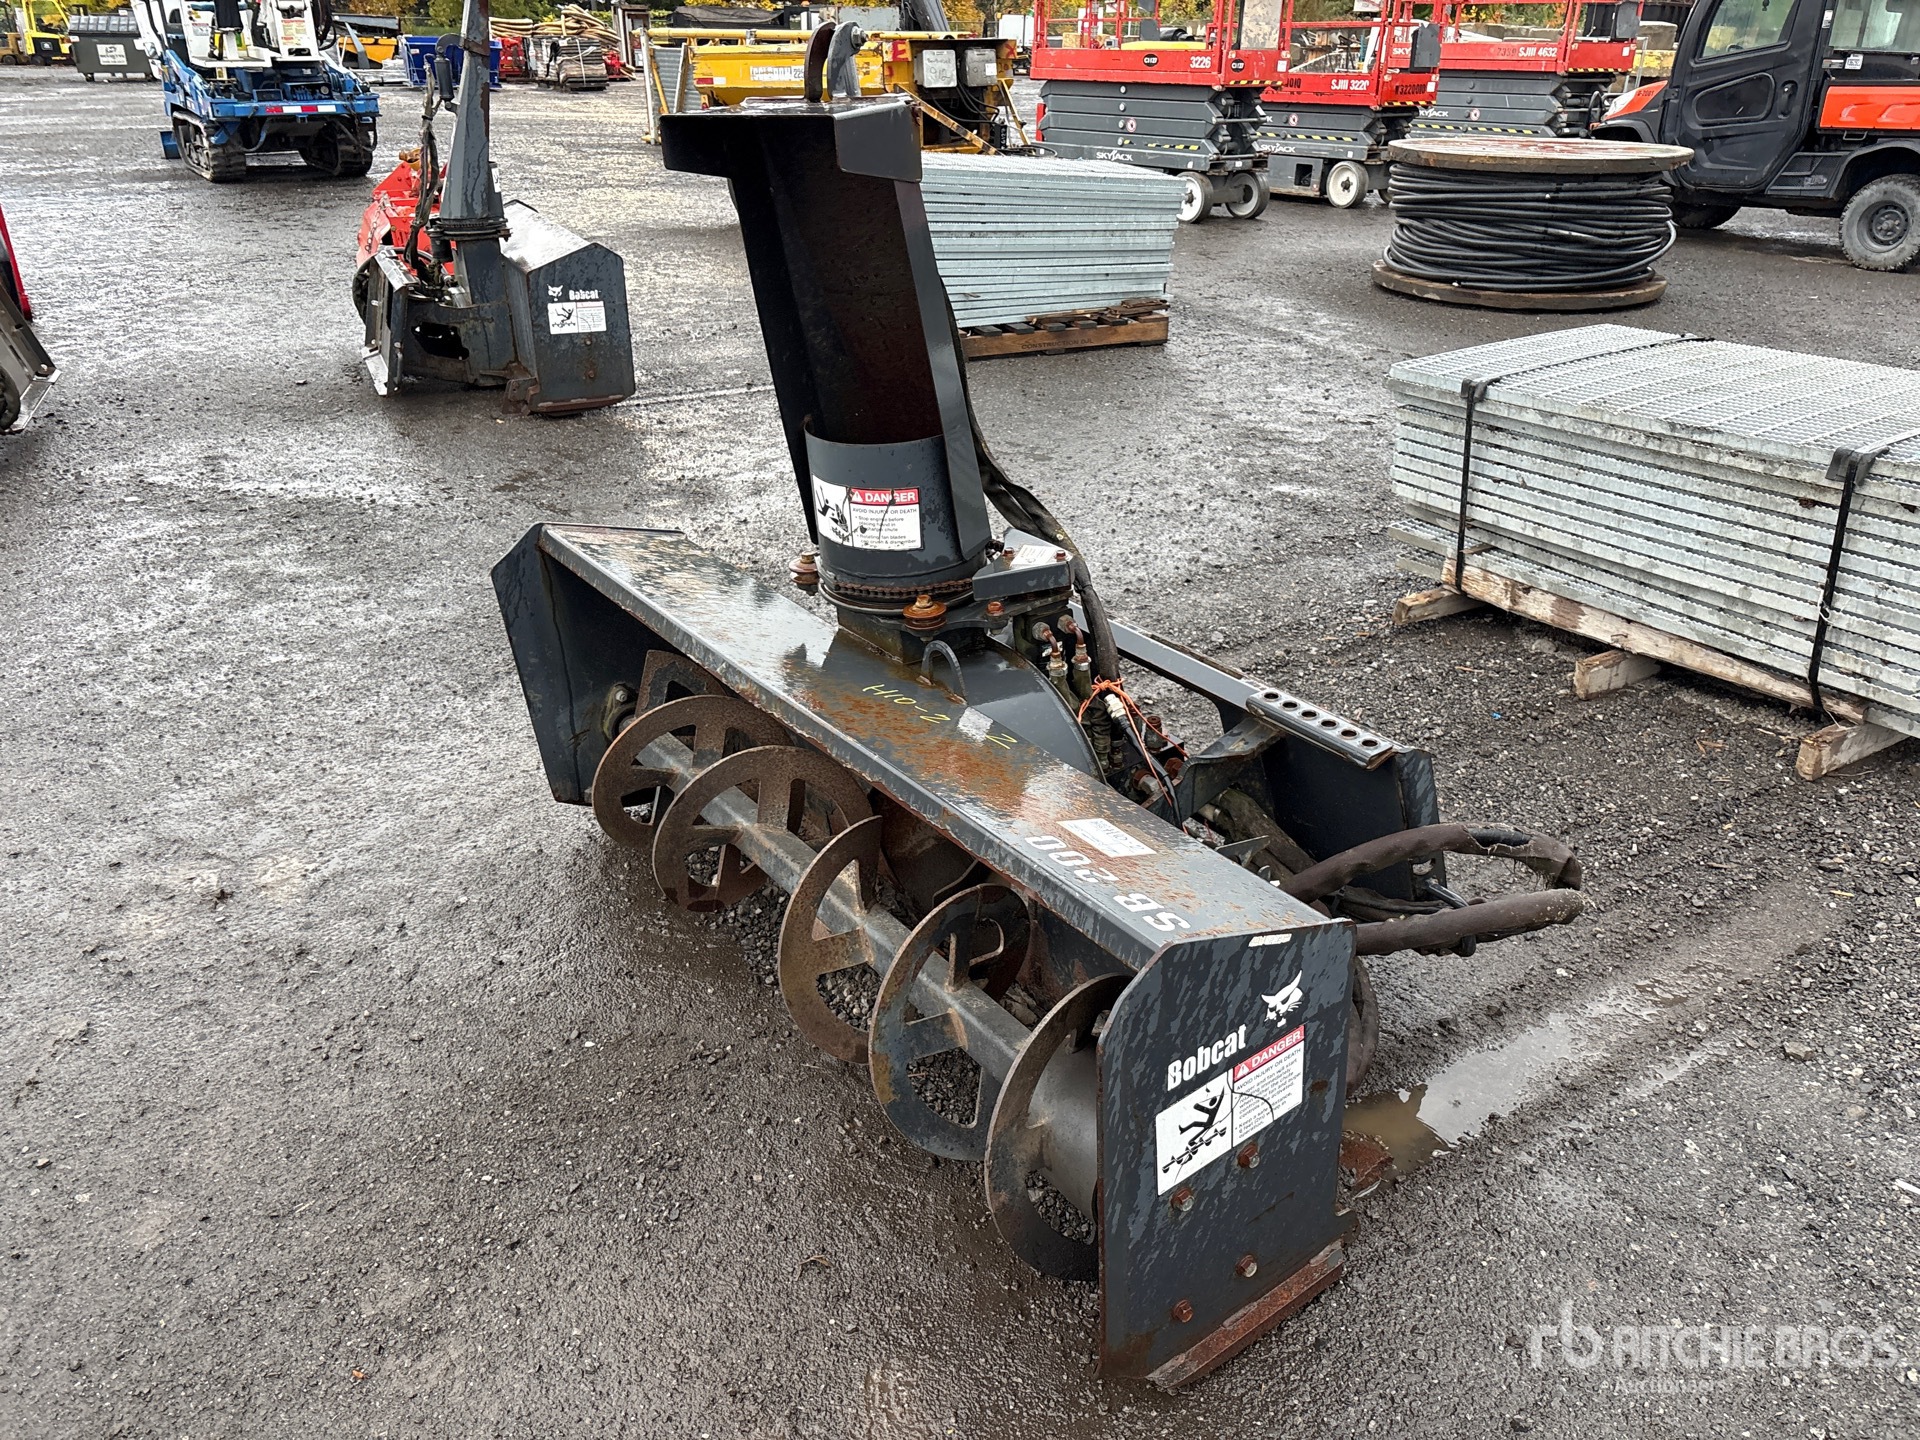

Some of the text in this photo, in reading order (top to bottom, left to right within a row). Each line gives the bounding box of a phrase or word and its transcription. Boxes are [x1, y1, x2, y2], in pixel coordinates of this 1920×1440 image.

[1537, 47, 1558, 57] 4632
[1190, 56, 1212, 69] 3226
[1260, 142, 1296, 153] SKYJACK
[1096, 149, 1133, 162] SKYJACK
[568, 289, 600, 300] Bobcat
[864, 491, 916, 503] DANGER
[1024, 835, 1120, 883] 200
[1113, 892, 1191, 932] SB
[1251, 1030, 1301, 1068] DANGER
[1167, 1023, 1247, 1092] Bobcat
[1236, 1047, 1300, 1091] AVOID INJURY OR DEATH
